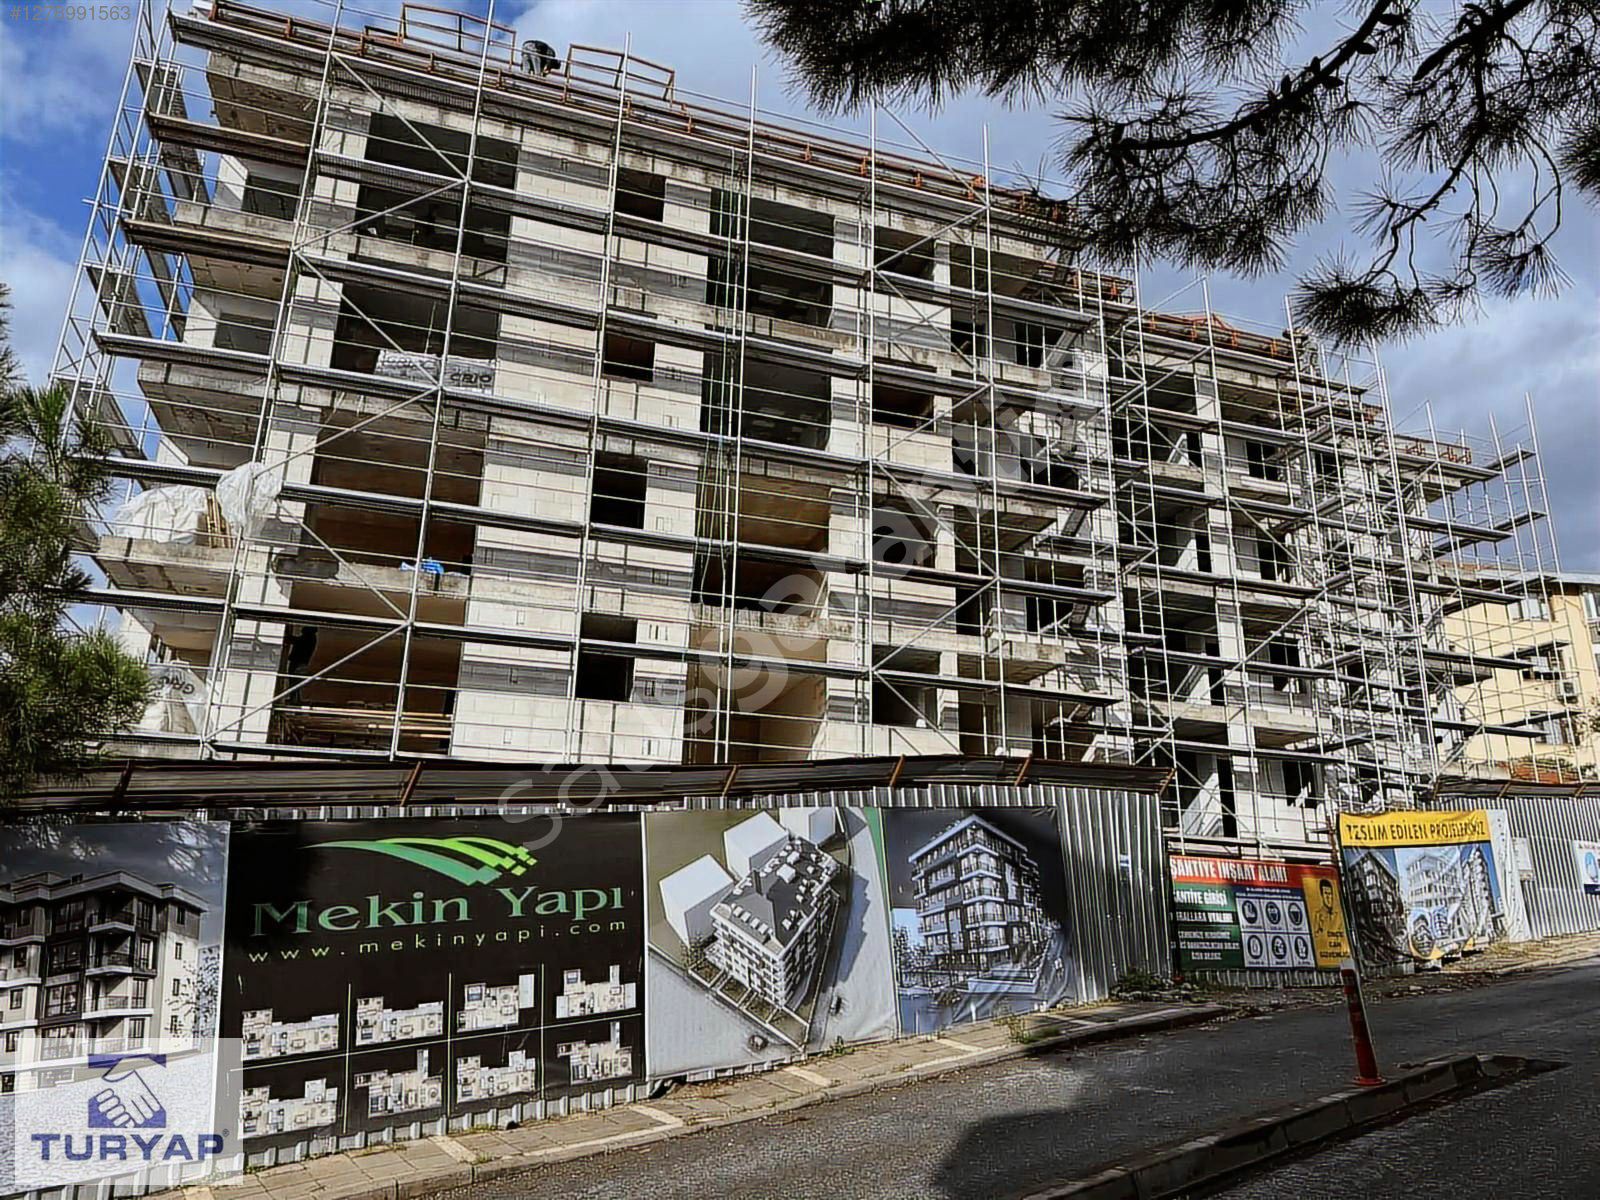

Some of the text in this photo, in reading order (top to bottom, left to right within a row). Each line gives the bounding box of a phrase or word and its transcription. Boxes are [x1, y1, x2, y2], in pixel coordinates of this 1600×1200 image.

[1391, 819, 1428, 840] EDİLEN
[251, 886, 624, 936] Mekin Yapı
[249, 921, 625, 963] www.mekinyapi.com
